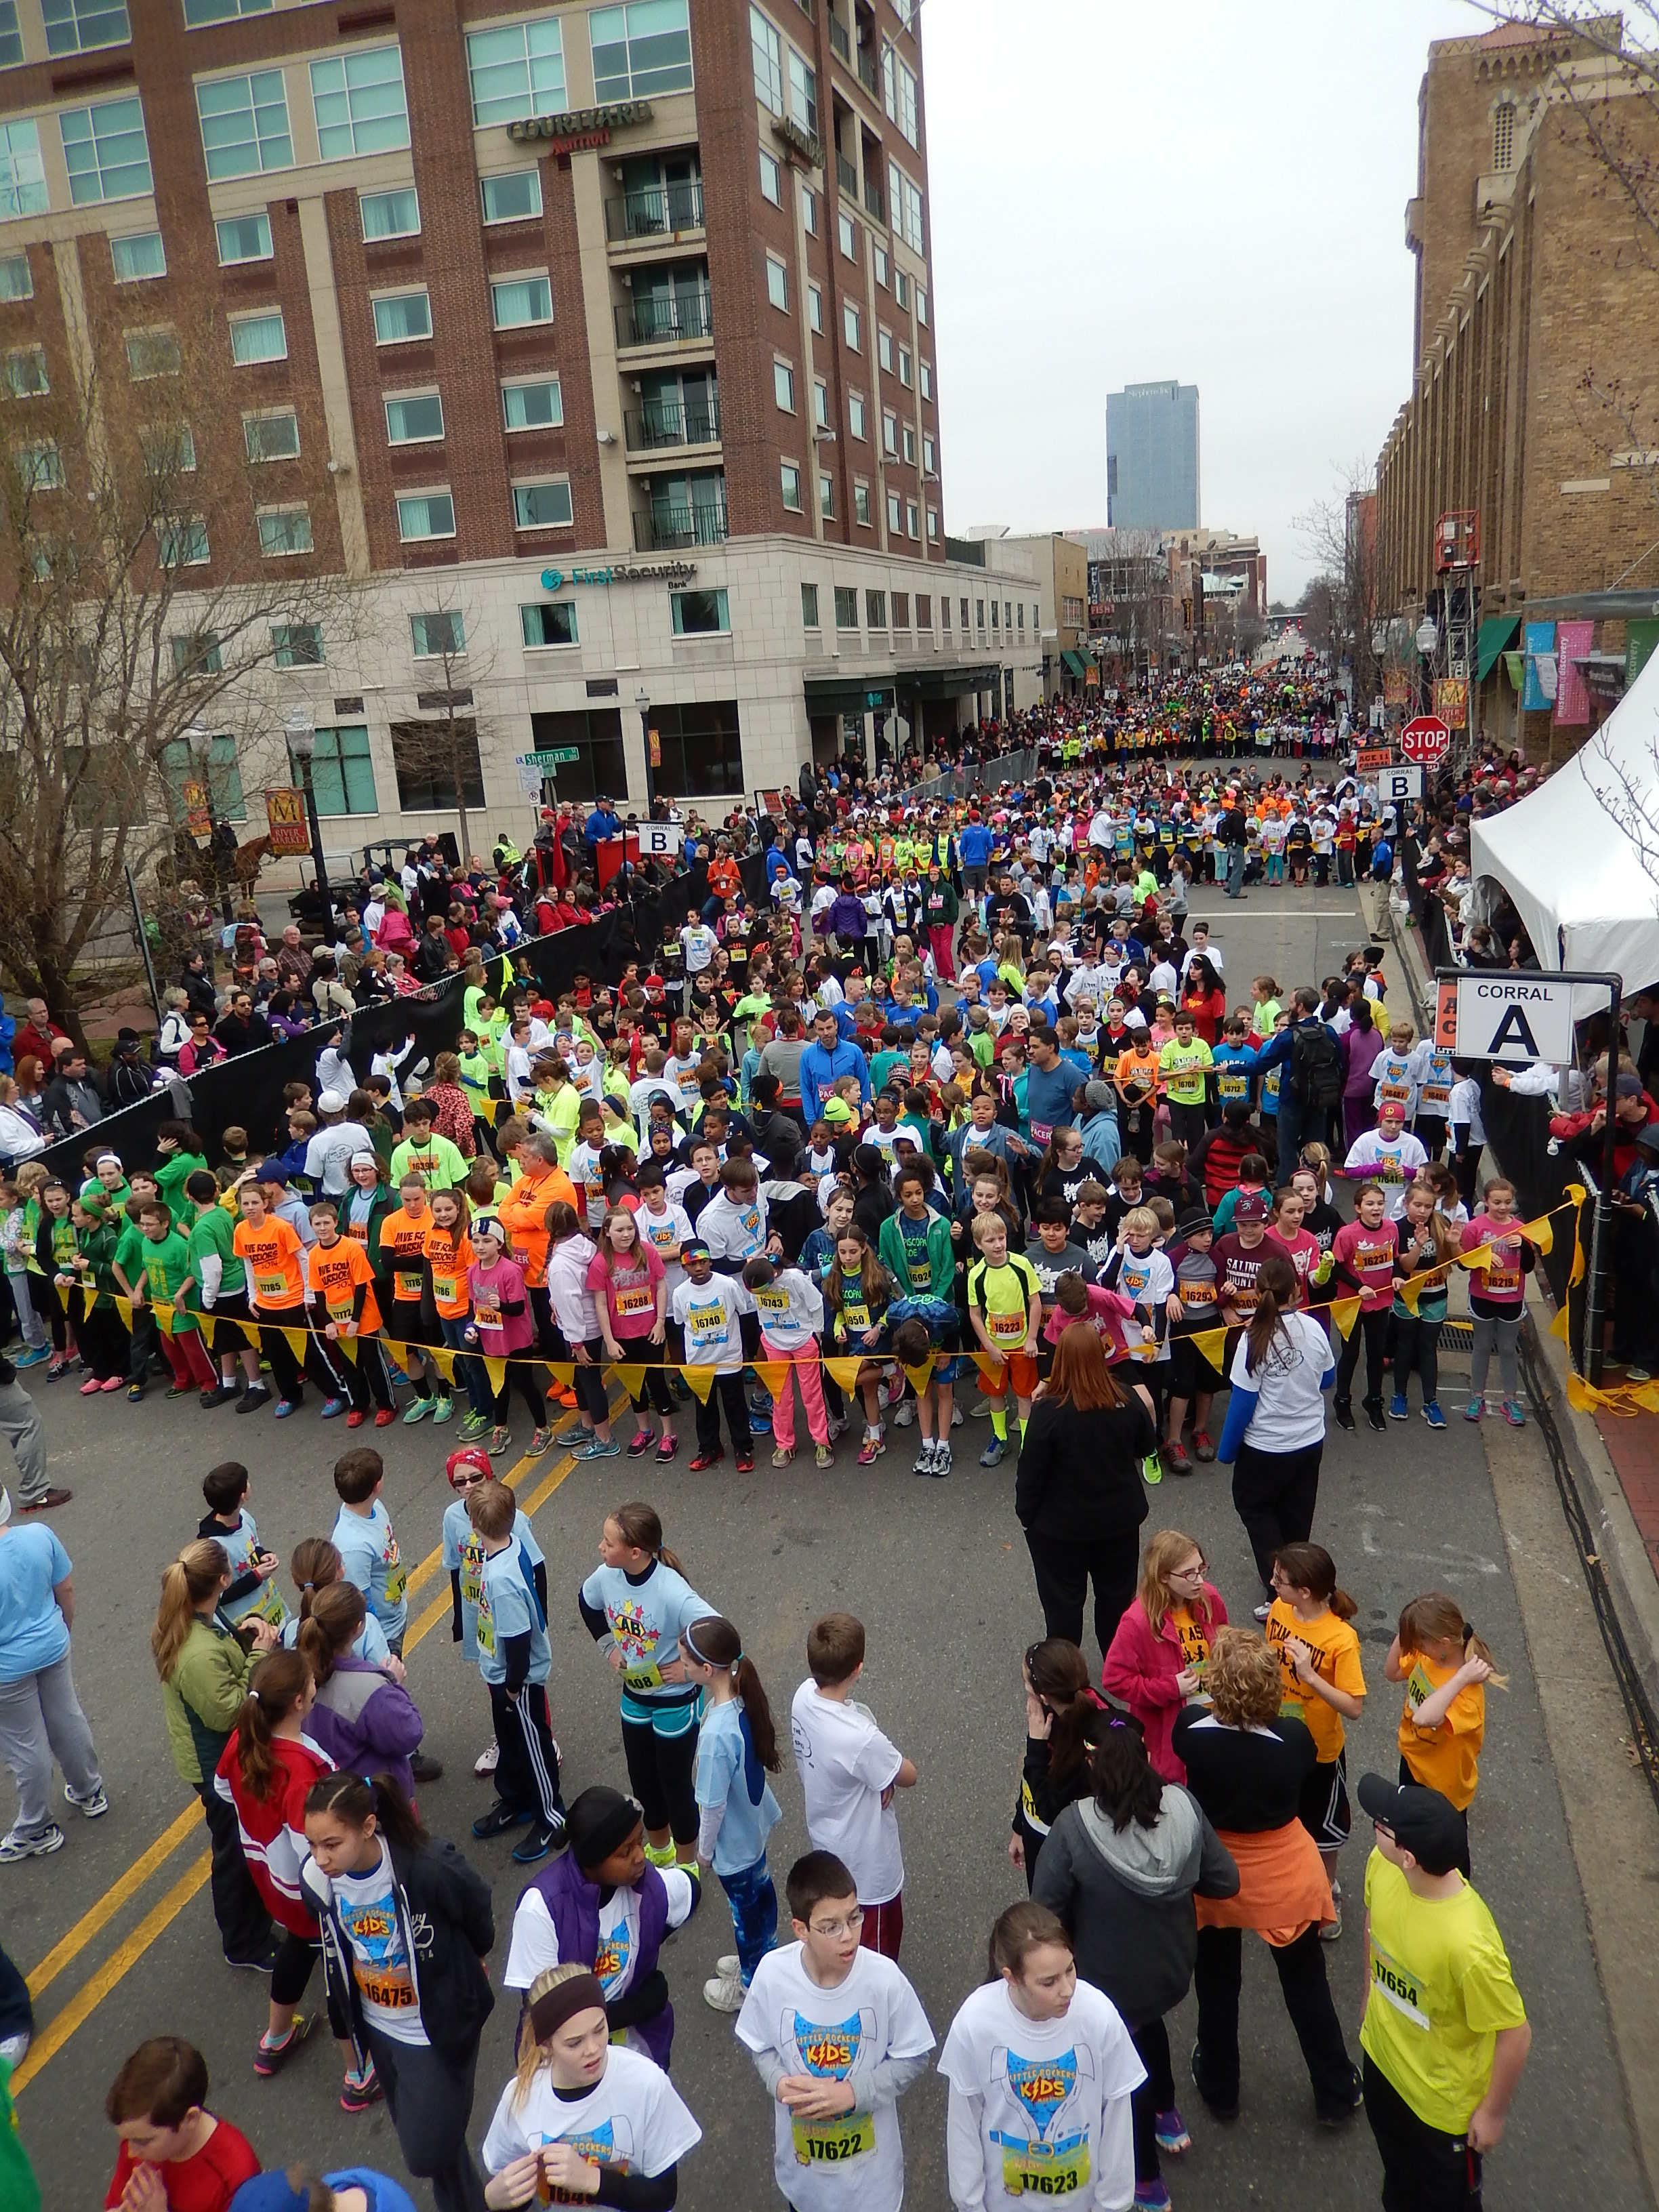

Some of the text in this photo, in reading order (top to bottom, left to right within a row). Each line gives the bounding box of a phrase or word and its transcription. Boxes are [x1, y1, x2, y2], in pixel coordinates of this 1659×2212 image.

[506, 100, 653, 143] COURTYARD
[550, 128, 610, 155] Marriott
[668, 581, 687, 590] Bank
[1561, 636, 1570, 676] discovery
[1558, 683, 1566, 718] museum
[1404, 731, 1446, 749] STOP
[526, 752, 566, 765] Sherman
[1359, 754, 1378, 762] AGE
[1392, 777, 1409, 798] B
[275, 828, 300, 836] RIVER
[272, 836, 306, 845] MARKET
[651, 832, 668, 851] B
[1477, 985, 1553, 1001] CORRAL
[1487, 1004, 1540, 1057] A
[1031, 1126, 1052, 1139] PACER
[1378, 1174, 1398, 1183] 17641
[655, 1232, 672, 1243] KIDS
[514, 1254, 529, 1264] CER
[1363, 1253, 1388, 1266] 16237
[1126, 1276, 1144, 1287] KIDS
[1488, 1277, 1513, 1287] 16219
[622, 1296, 649, 1309] 16288
[760, 1296, 783, 1308] 16743
[1186, 1291, 1213, 1302] 16293
[695, 1315, 720, 1328] 16740
[994, 1322, 1020, 1333] 16223
[621, 1616, 645, 1639] AB
[1410, 1680, 1425, 1707] 1746
[352, 1917, 390, 1938] KIDS
[1375, 1960, 1418, 2007] 17654
[365, 1983, 412, 2006] 16475
[796, 2033, 860, 2045] LITTLE ROCKERS
[806, 2041, 851, 2067] KIDS
[1009, 2068, 1076, 2083] LITTLE ROCKERS
[1019, 2076, 1066, 2103] KIDS
[806, 2133, 863, 2160] 17622
[1019, 2170, 1078, 2194] 17623
